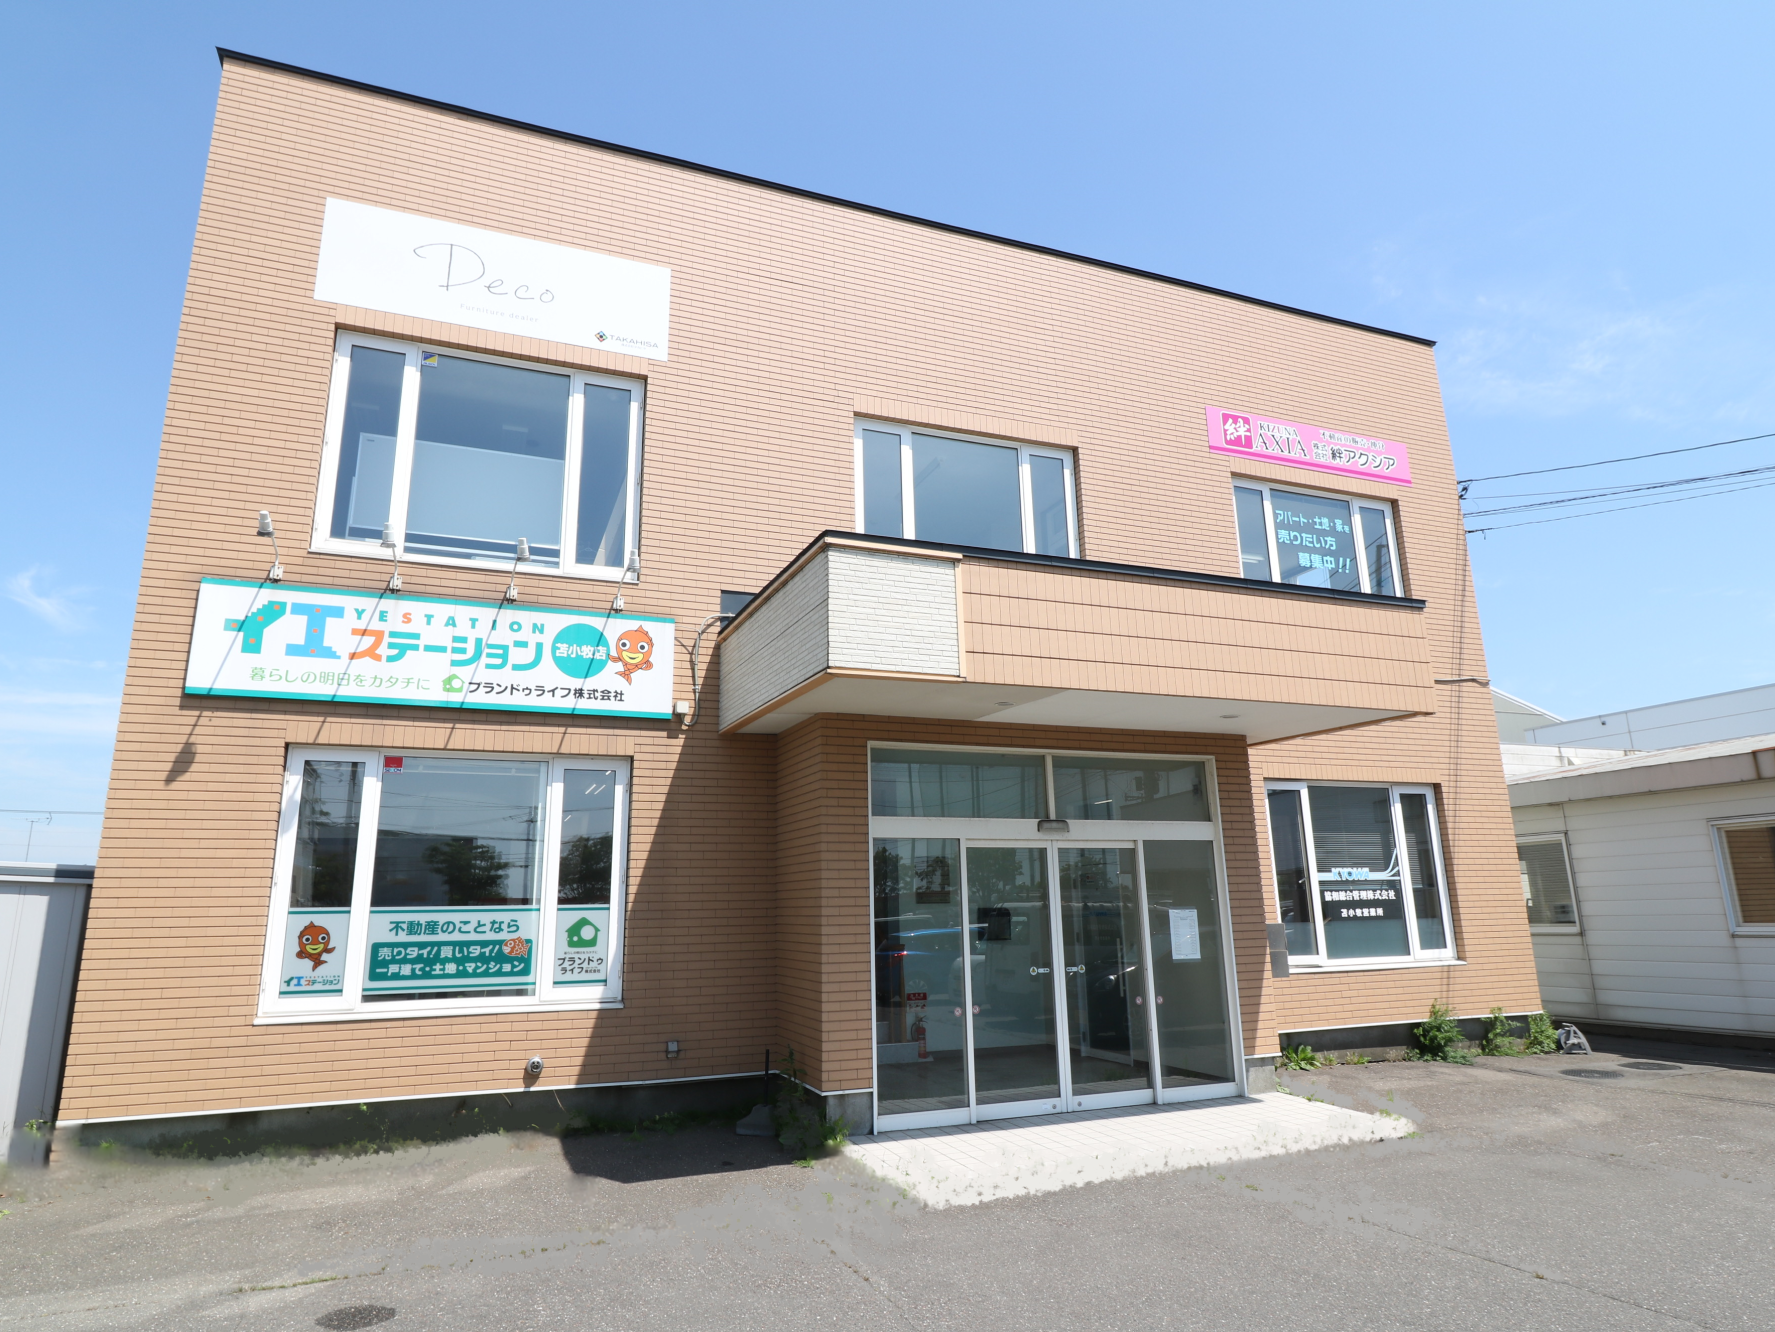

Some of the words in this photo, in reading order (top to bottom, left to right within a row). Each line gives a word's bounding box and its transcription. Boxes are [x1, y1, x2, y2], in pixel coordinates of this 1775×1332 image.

[413, 242, 555, 304] Deco
[460, 303, 505, 317] Furniture
[508, 312, 539, 323] dealer
[610, 334, 659, 348] TAKAHISA
[1224, 417, 1252, 446] 絆
[1259, 422, 1298, 437] KIZUNA
[1255, 432, 1308, 457] AXIA
[1330, 446, 1396, 471] 絆アクシア
[1277, 529, 1336, 550] 売りたい方
[354, 608, 545, 635] YESTATION
[555, 643, 607, 660] 苫小牧店
[249, 667, 430, 690] 暮らしの明日をカタチに
[1331, 868, 1370, 881] KYOWA
[388, 919, 521, 937] 不動産のことなら
[375, 961, 525, 977] 一戸建て・土地・マンション
[560, 966, 584, 975] ライフ
